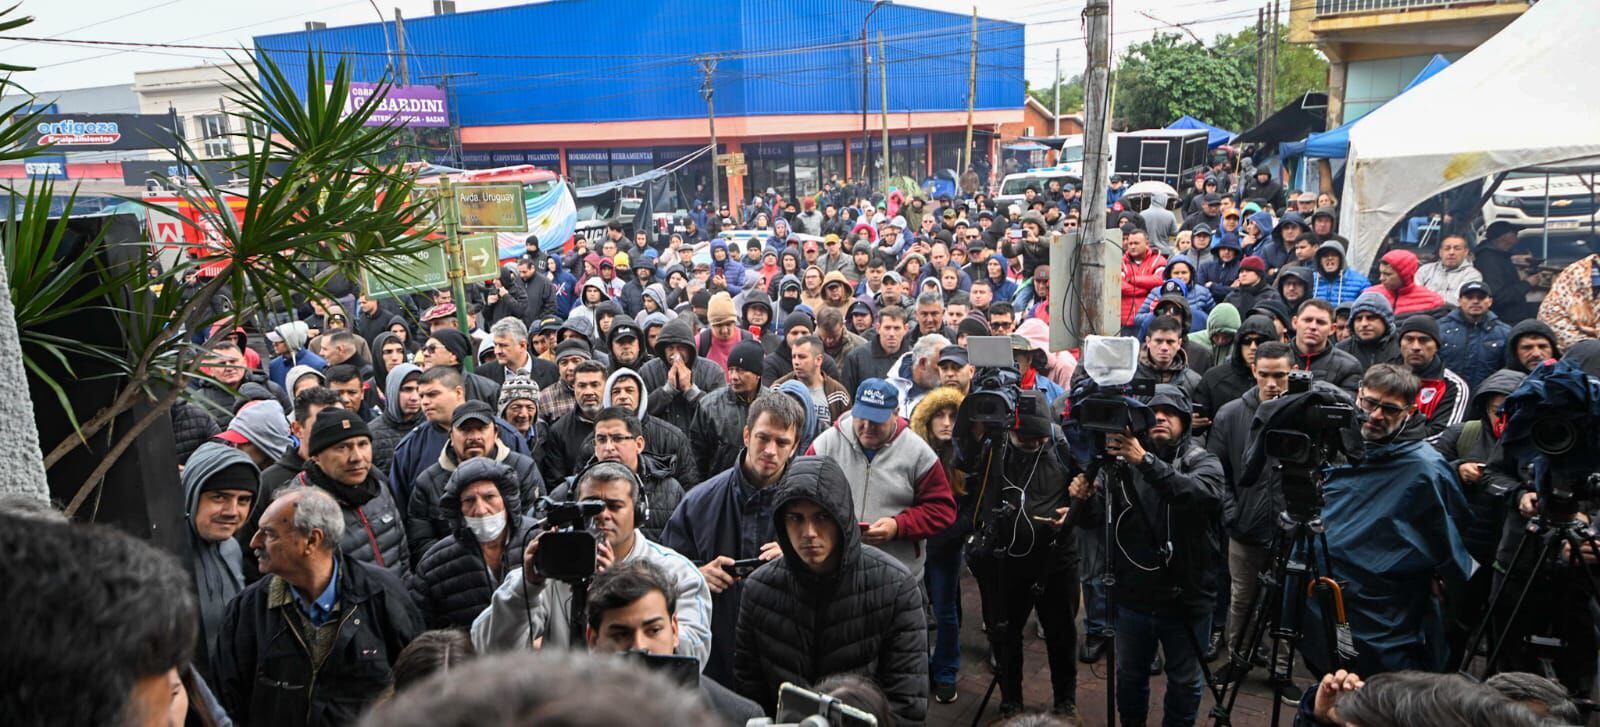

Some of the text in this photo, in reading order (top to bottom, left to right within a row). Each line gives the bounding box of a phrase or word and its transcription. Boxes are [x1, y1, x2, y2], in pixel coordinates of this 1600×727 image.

[38, 120, 119, 134] ortigoza
[568, 152, 608, 160] HORMIGONERAS
[611, 151, 653, 160] HERRAMIENTAS
[482, 192, 514, 204] Uruguay
